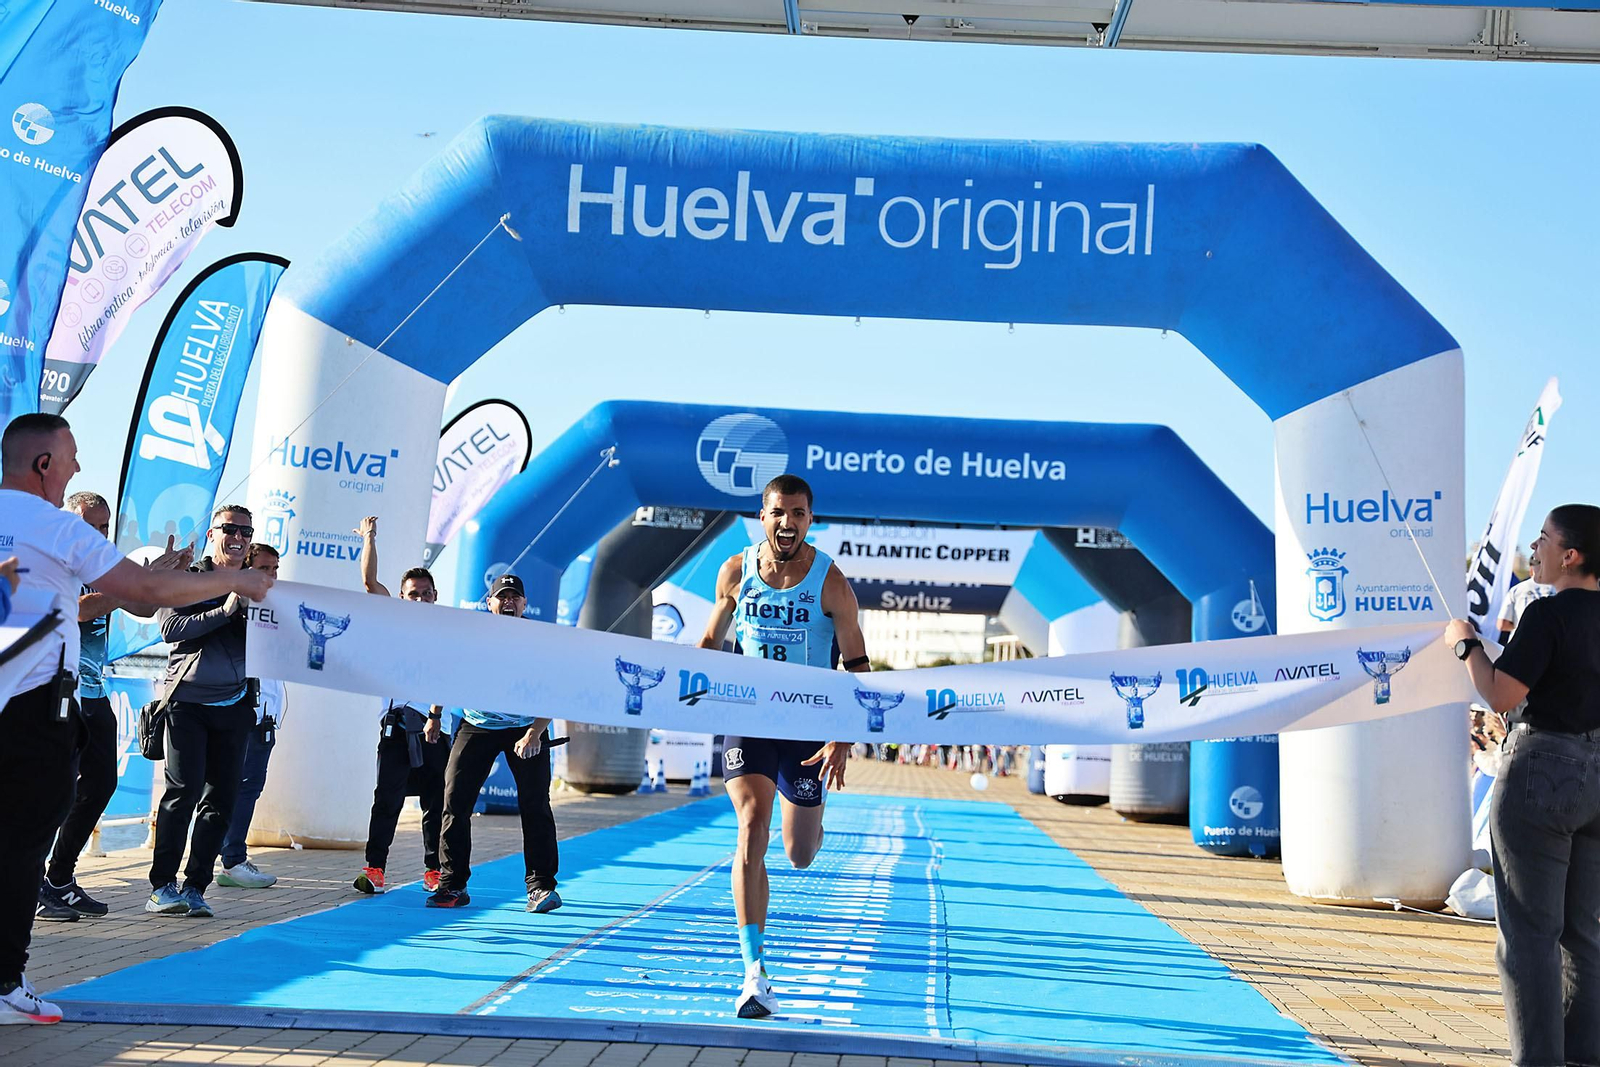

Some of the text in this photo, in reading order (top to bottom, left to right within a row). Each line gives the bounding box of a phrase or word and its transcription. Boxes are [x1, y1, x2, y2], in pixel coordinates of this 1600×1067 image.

[13, 151, 31, 166] de
[34, 157, 82, 184] Huelva
[146, 174, 217, 235] TELECOM
[566, 163, 1155, 270] Huelva original
[78, 314, 105, 352] fibra
[104, 285, 136, 320] óptica
[180, 199, 227, 239] televisión
[170, 299, 229, 404] HUELVA
[202, 305, 241, 407] PUERTA DEL DESCUBRIMIENTO
[269, 436, 388, 478] Huelva
[806, 444, 1067, 480] Puerto de Huelva
[338, 479, 385, 493] original
[1306, 490, 1433, 524] Huelva
[299, 528, 363, 544] Ayuntamiento
[1389, 526, 1433, 540] original
[296, 541, 362, 562] HUELV
[838, 541, 1010, 562] ATLANTIC COPPER
[1355, 584, 1434, 595] Ayuntamiento de
[1355, 596, 1434, 611] HUELVA
[745, 601, 811, 626] nerja
[758, 644, 787, 662] 18
[1208, 670, 1258, 689] HUELVA
[1275, 663, 1340, 682] AVATEL
[708, 681, 757, 700] HUELVA
[770, 691, 834, 706] AVATEL
[956, 692, 1005, 708] HUELVA
[1021, 688, 1085, 705] AVATEL
[1203, 826, 1236, 837] Puerto
[1238, 826, 1253, 836] de
